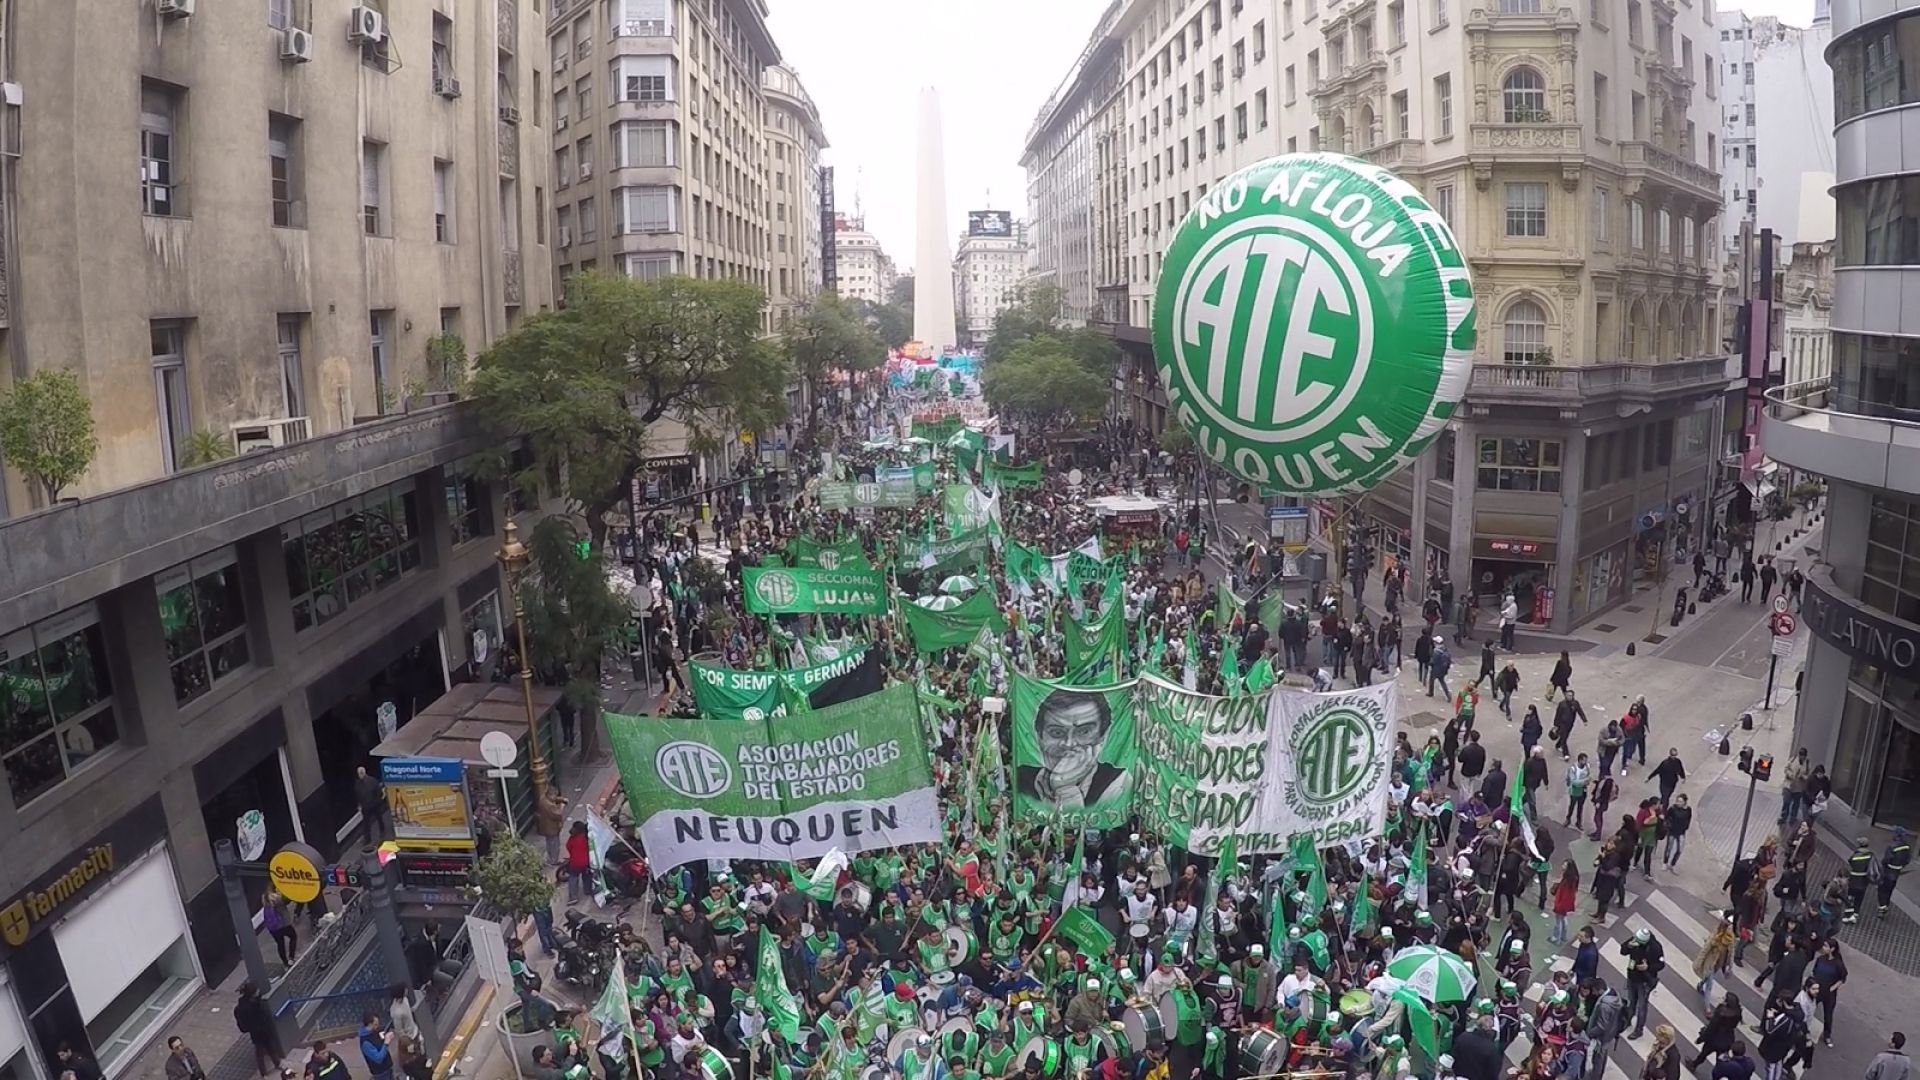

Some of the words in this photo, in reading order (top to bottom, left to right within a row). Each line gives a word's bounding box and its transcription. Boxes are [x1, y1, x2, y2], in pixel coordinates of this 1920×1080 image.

[1199, 178, 1249, 229] NO
[1261, 170, 1413, 276] AFLOJA
[1184, 233, 1351, 424] ATE
[1160, 364, 1393, 489] NEUQUEN
[645, 457, 690, 468] COWENS
[808, 572, 875, 586] SECCIONAL
[812, 590, 876, 605] LUJAN
[804, 651, 867, 685] GERMAN
[738, 729, 859, 764] ASOCIACION
[740, 740, 900, 783] TRABAJADORES
[1300, 718, 1364, 796] ATE
[384, 765, 418, 774] Diagonal
[420, 765, 442, 773] Norte
[663, 744, 726, 794] ATE
[744, 781, 784, 800] DEL
[791, 773, 865, 799] ESTADO
[674, 805, 899, 845] NEUQUEN
[1169, 783, 1255, 830] ESTADO
[25, 842, 113, 922] farmacity
[275, 866, 313, 881] Subte
